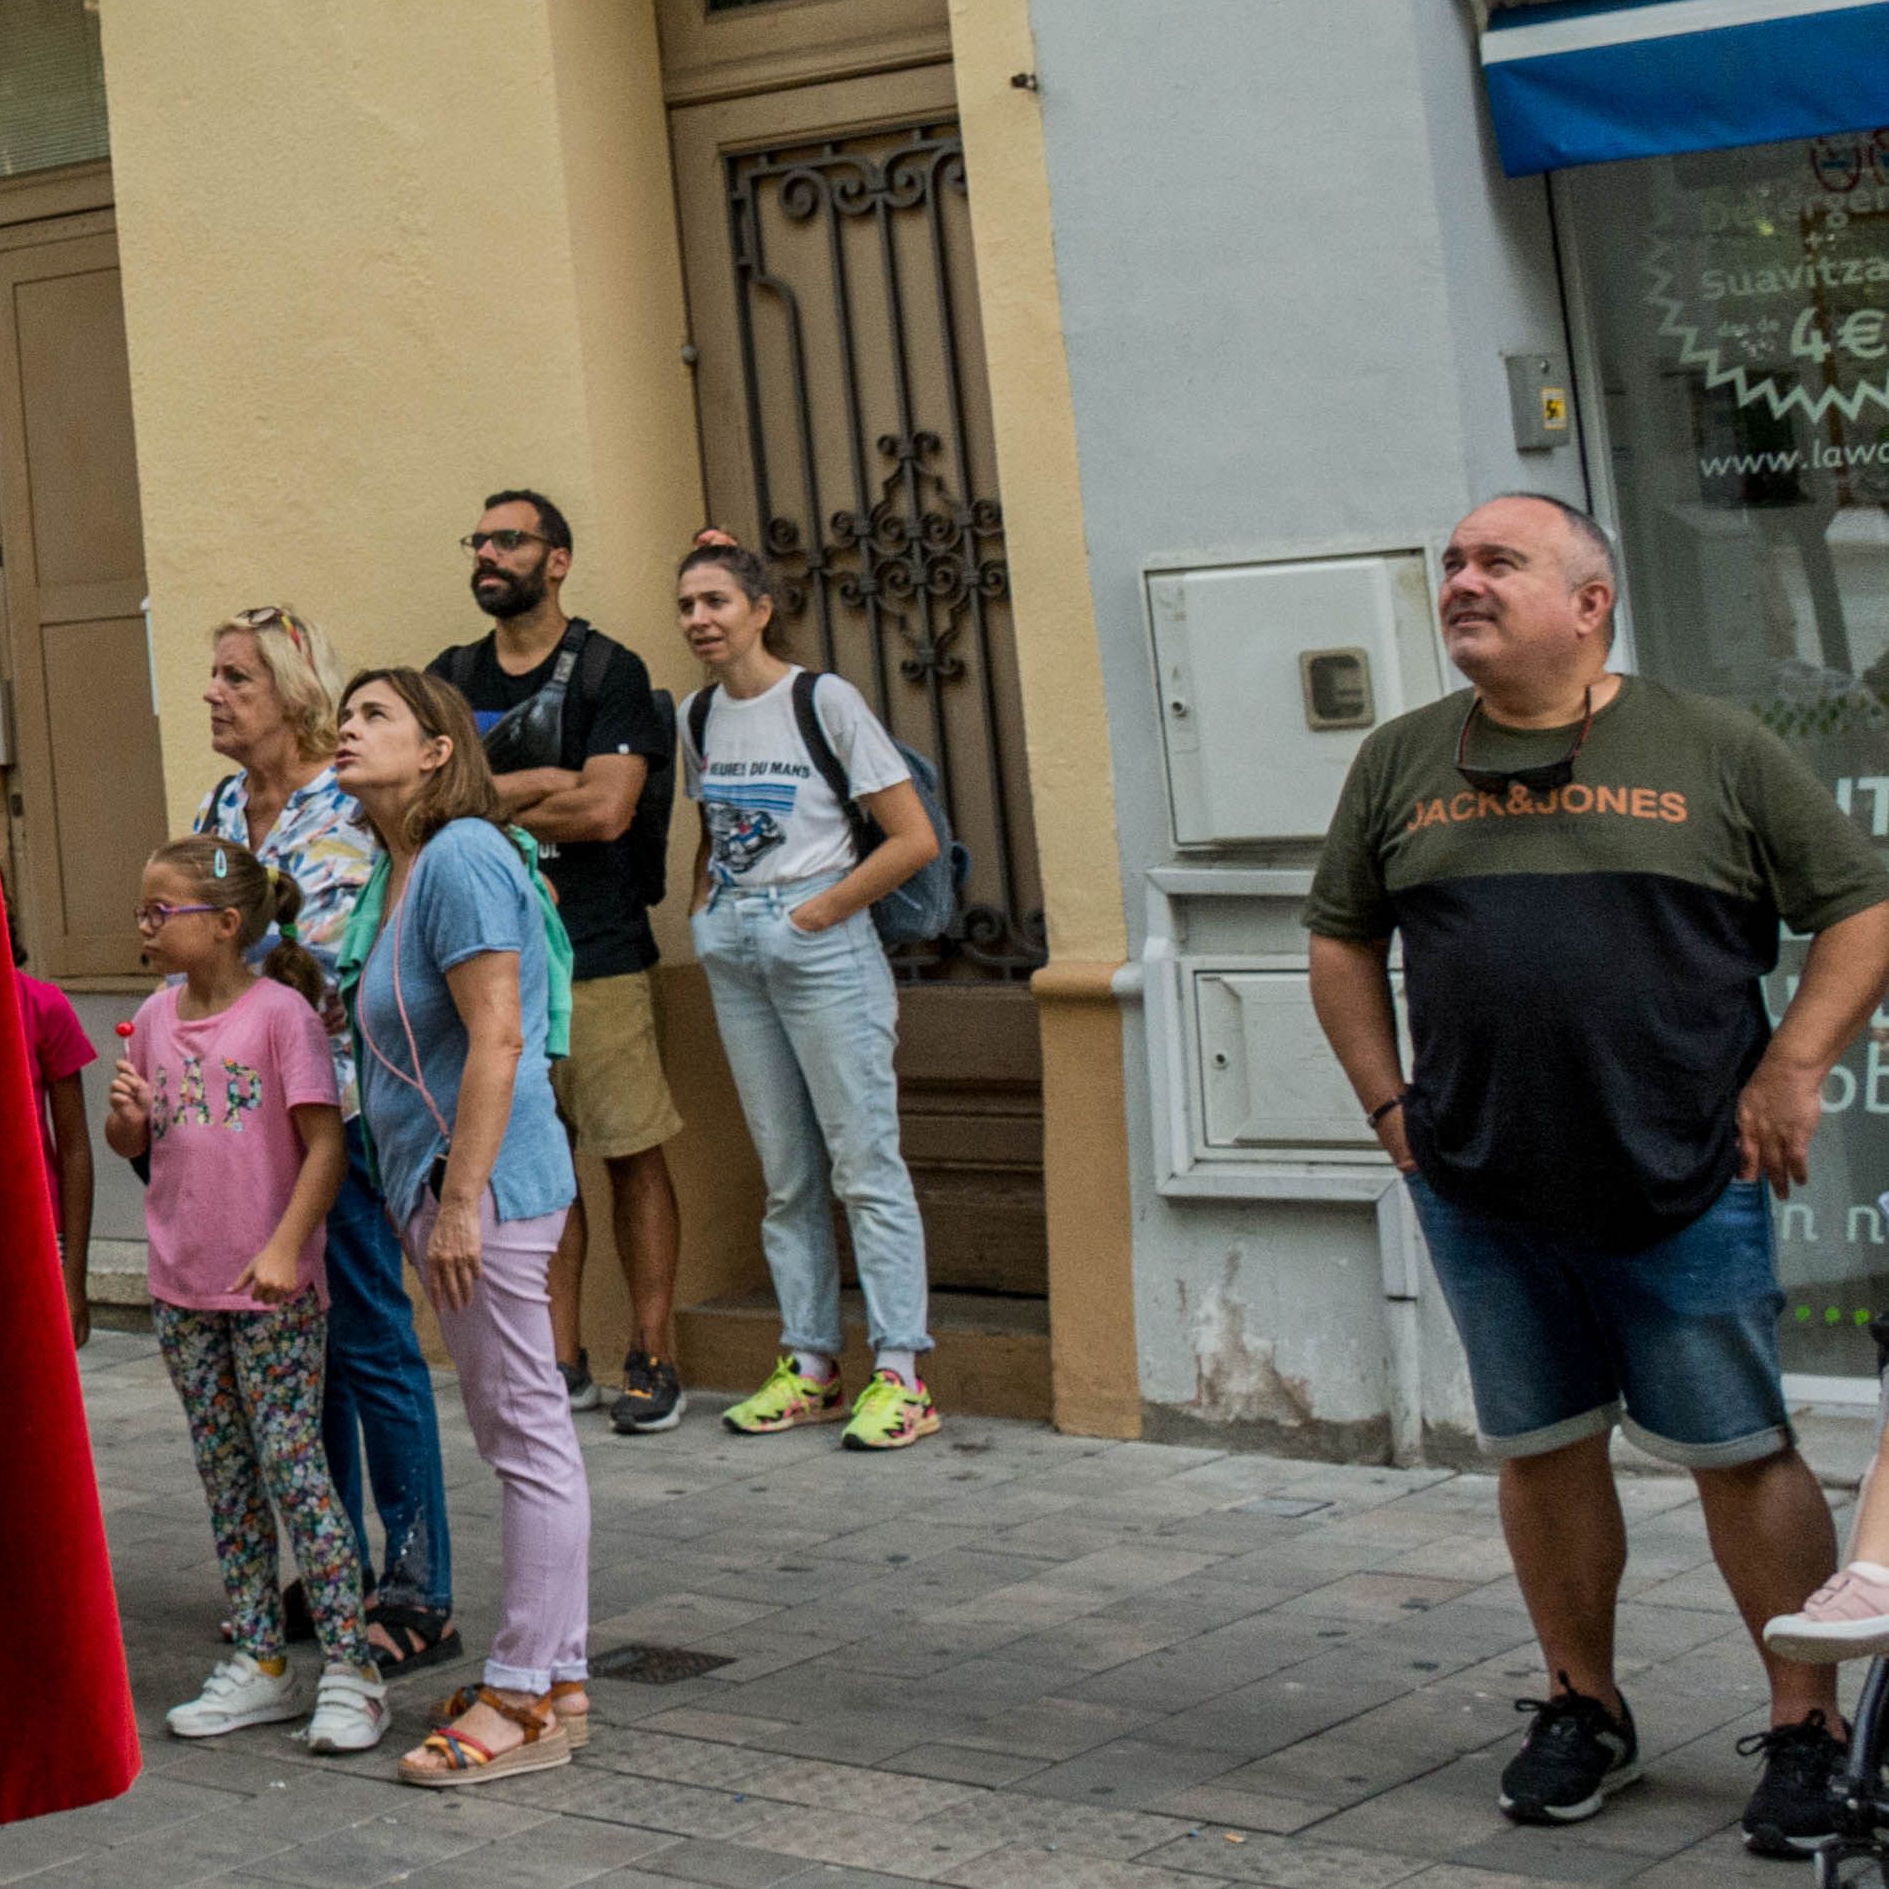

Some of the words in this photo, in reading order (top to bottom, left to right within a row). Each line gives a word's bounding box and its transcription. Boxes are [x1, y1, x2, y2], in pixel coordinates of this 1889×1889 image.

[749, 762, 769, 777] DU
[770, 762, 811, 779] MANS
[1406, 784, 1690, 832] JACK&JONES
